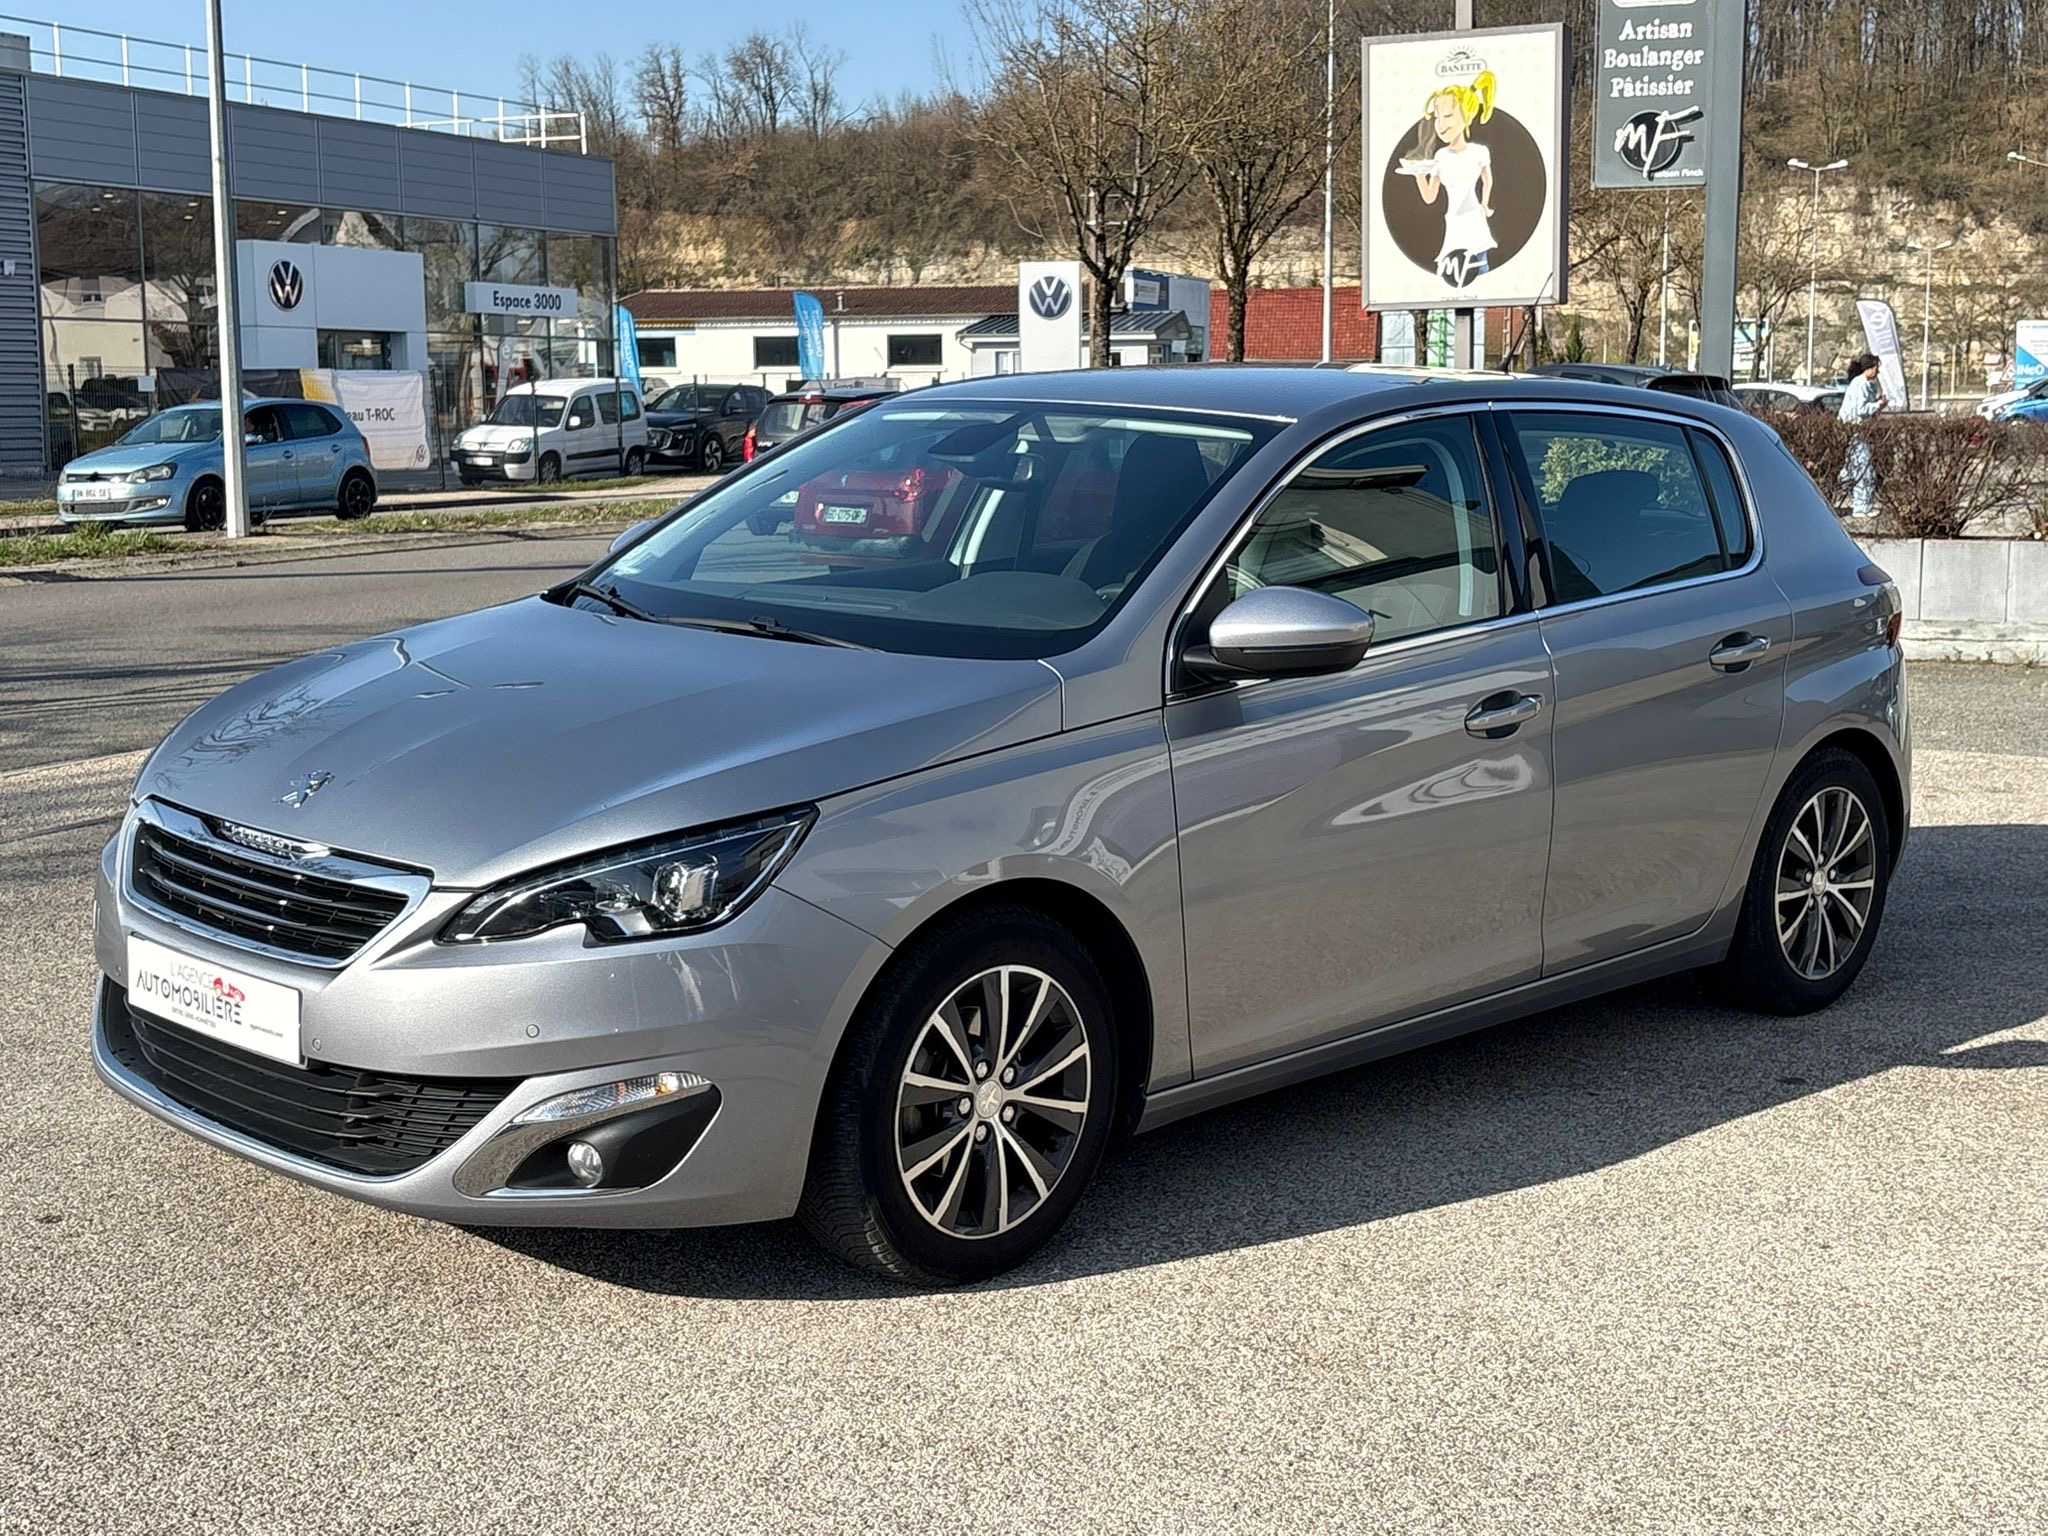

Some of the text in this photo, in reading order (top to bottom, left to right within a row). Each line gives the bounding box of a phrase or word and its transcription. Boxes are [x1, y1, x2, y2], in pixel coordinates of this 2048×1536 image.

[1618, 18, 1693, 41] Artisan
[1440, 63, 1482, 74] BANETTE
[1603, 45, 1704, 71] Boulanger
[1609, 74, 1694, 98] Pâtissier
[493, 290, 562, 311] Espace 3000
[1029, 273, 1072, 320] VW
[365, 407, 396, 421] T-ROC
